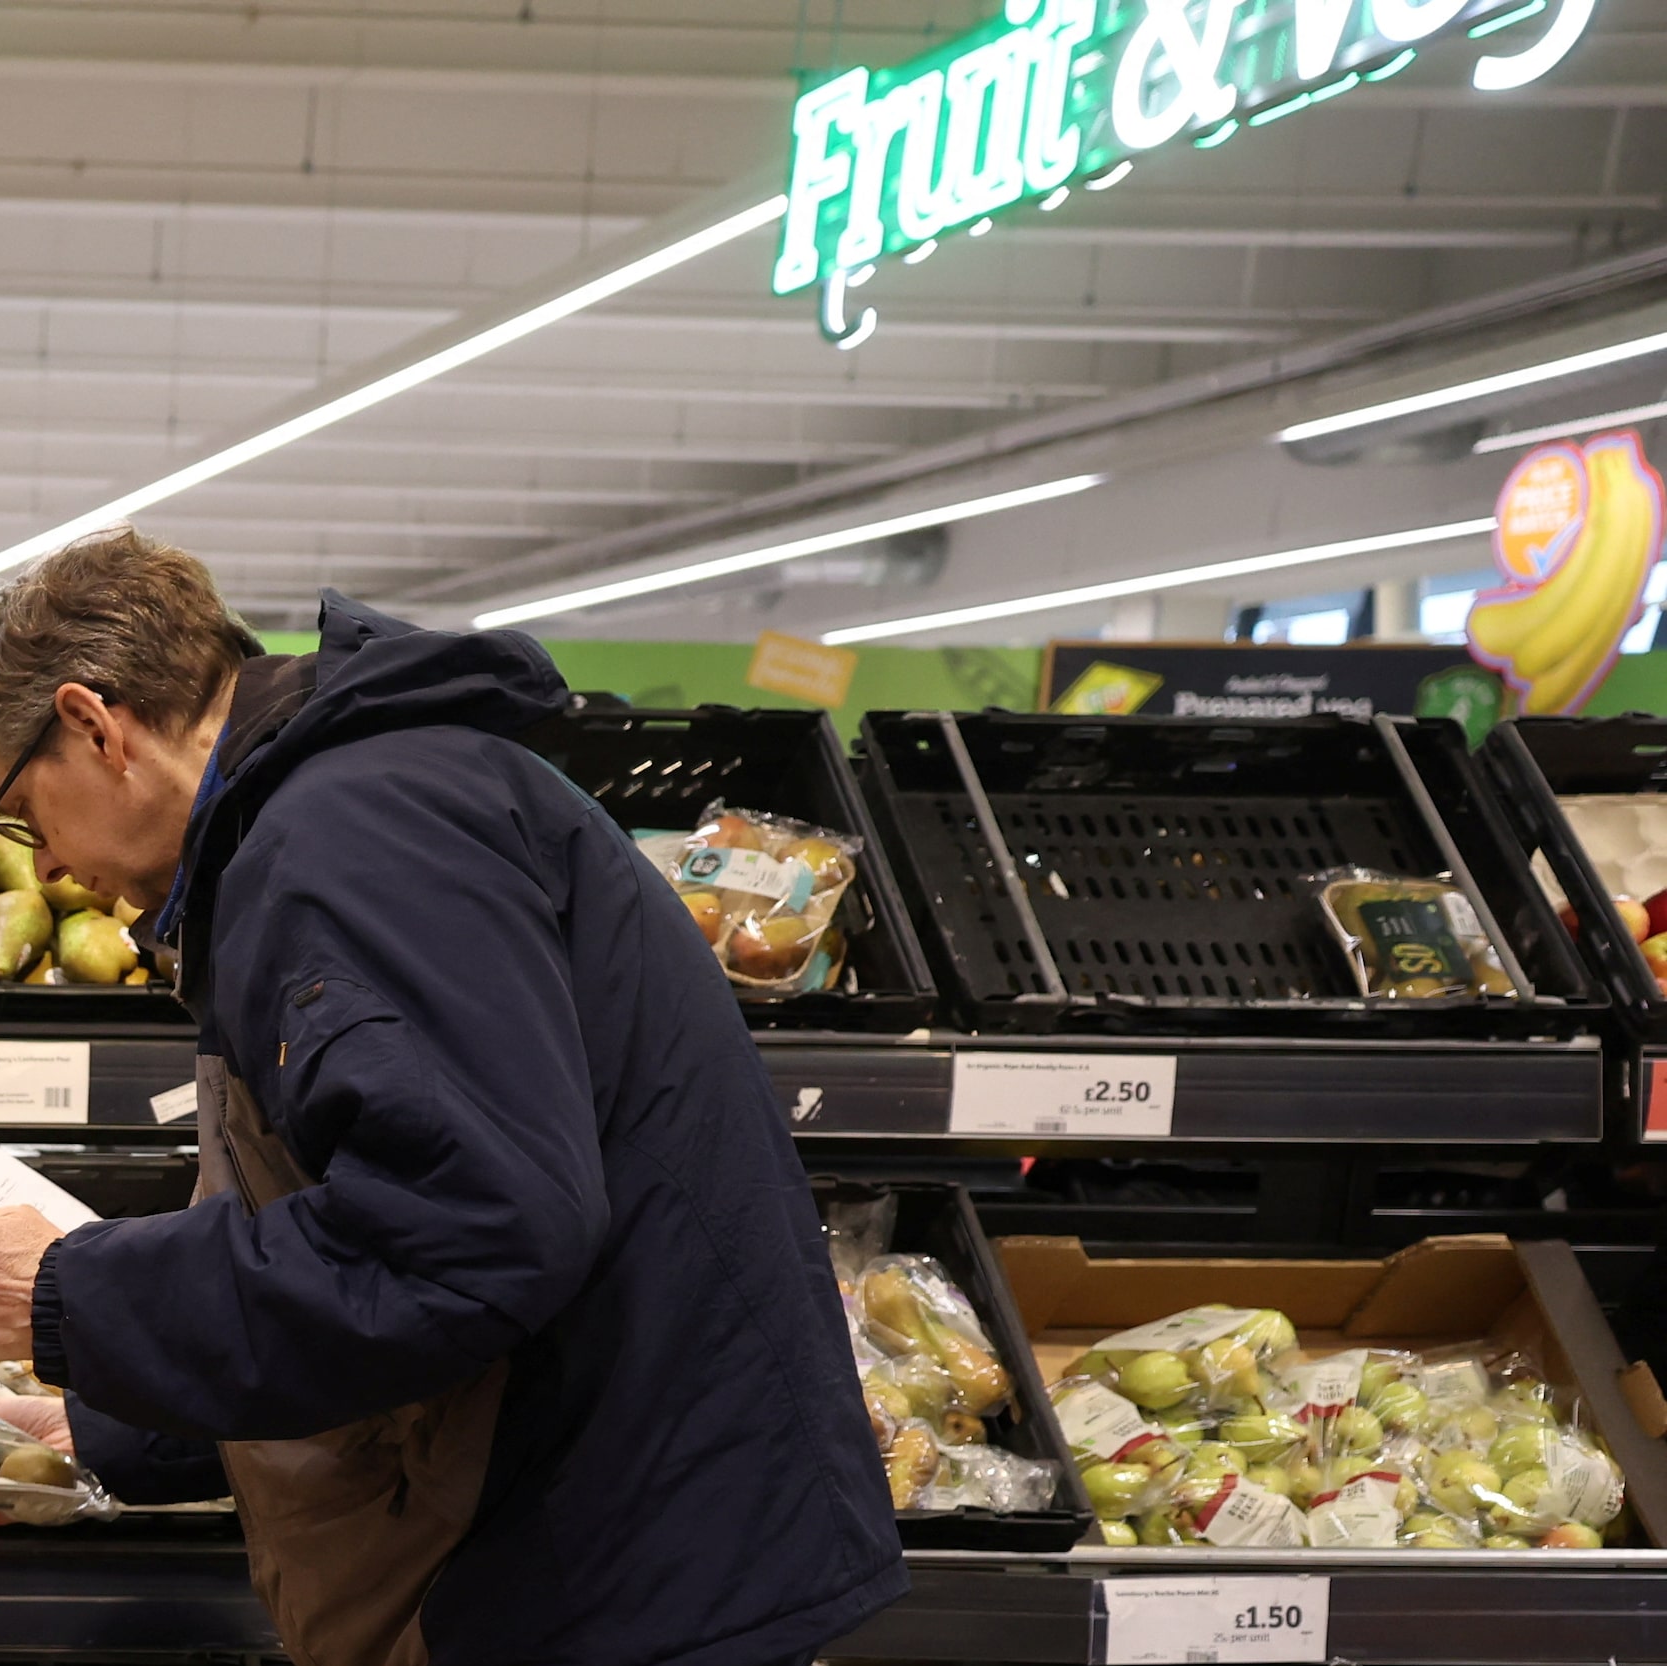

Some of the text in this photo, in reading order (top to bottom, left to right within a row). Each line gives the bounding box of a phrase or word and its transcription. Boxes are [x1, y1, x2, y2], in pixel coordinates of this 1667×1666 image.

[774, 0, 1095, 295] Fruit
[1085, 1081, 1151, 1102] £2.50
[1085, 1107, 1101, 1117] per
[1235, 1605, 1303, 1629] £1.50
[1231, 1634, 1248, 1644] per
[1250, 1632, 1270, 1642] unit
